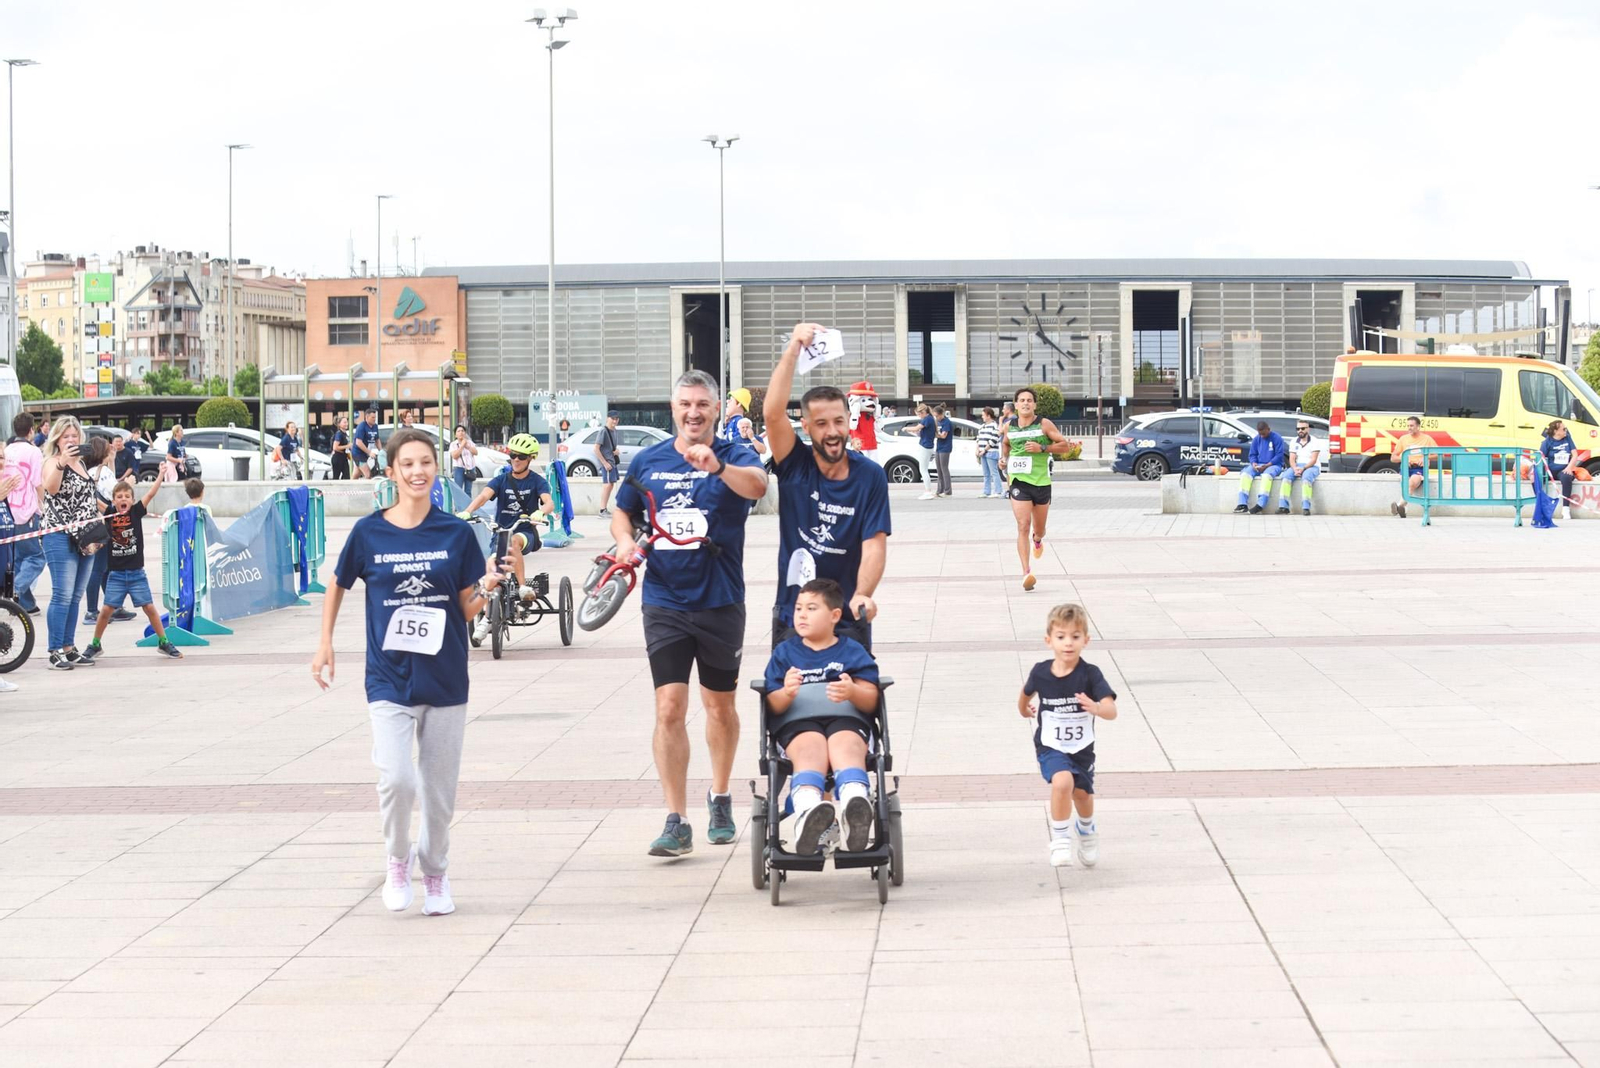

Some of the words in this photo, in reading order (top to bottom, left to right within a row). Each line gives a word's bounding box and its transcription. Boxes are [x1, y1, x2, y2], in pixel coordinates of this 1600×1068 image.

[382, 318, 442, 337] adif
[1180, 446, 1229, 455] POLICIA
[1180, 452, 1241, 461] NACIONAL
[666, 521, 695, 536] 154
[382, 552, 414, 563] CARRERA
[415, 550, 448, 561] SOLIDARIA
[216, 566, 262, 588] Córdoba
[395, 619, 429, 637] 156
[1054, 726, 1084, 741] 153
